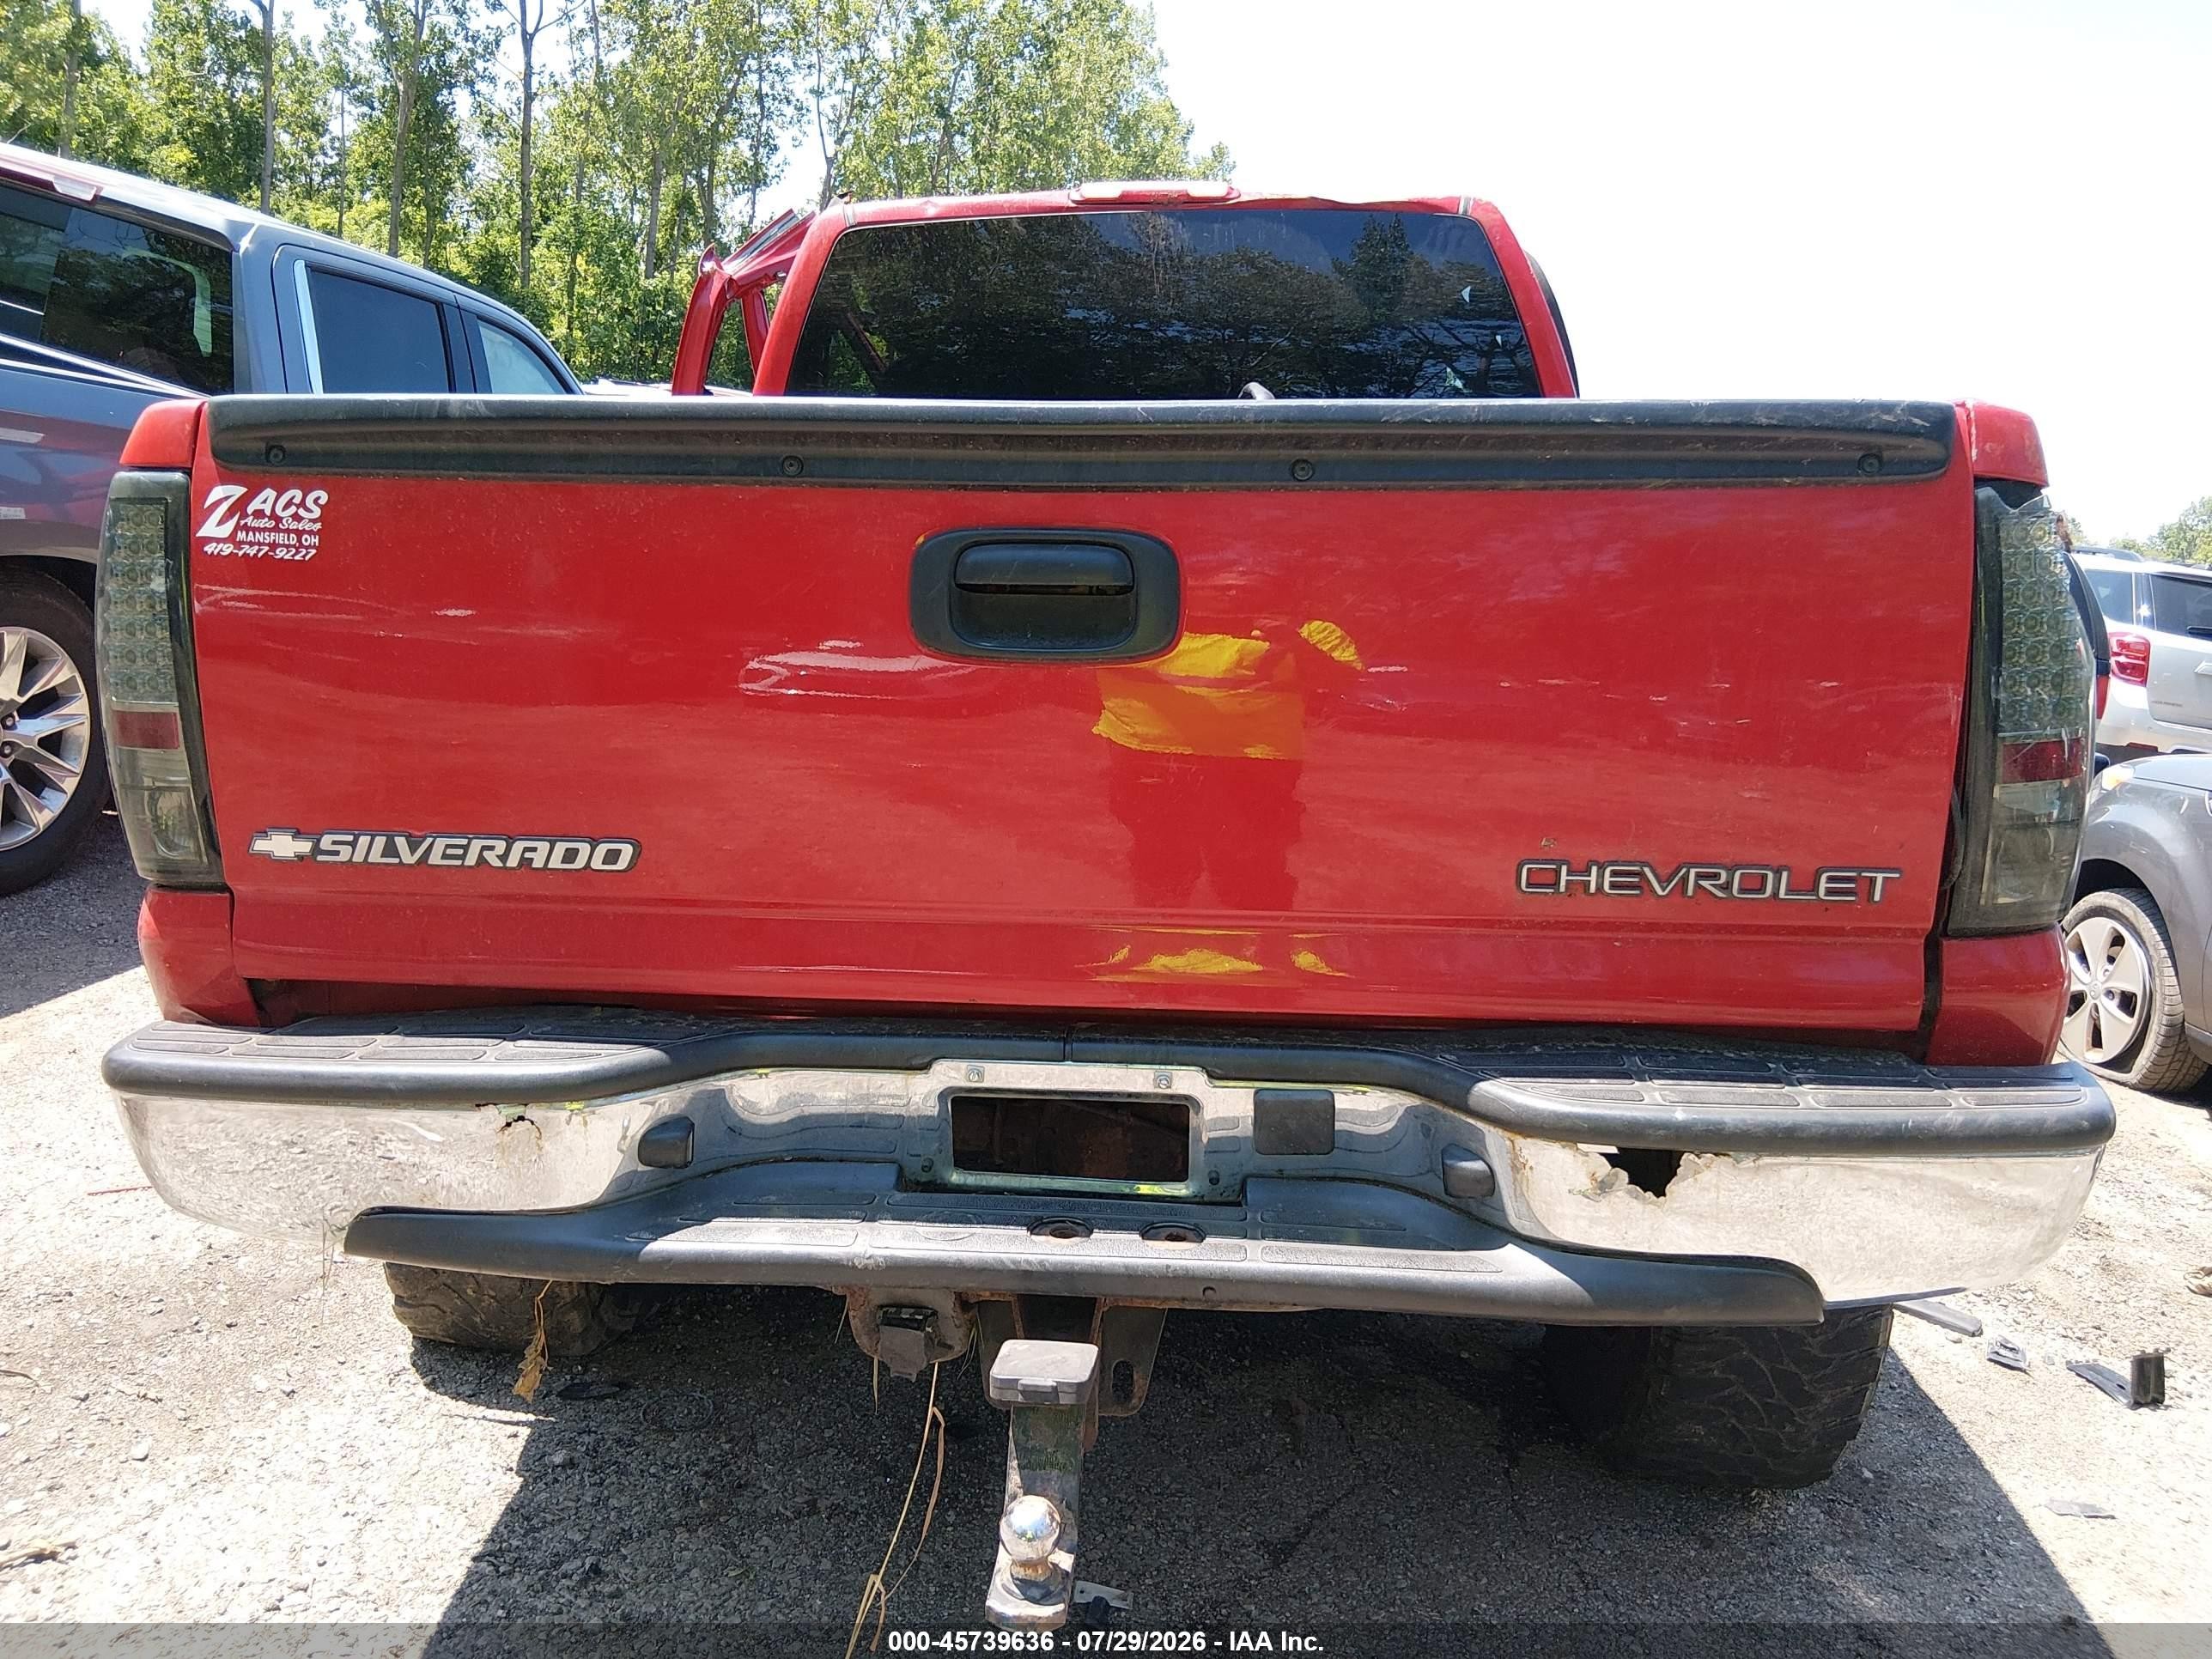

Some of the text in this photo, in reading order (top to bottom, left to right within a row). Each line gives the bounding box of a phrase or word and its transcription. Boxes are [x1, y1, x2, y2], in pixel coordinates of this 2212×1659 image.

[240, 515, 322, 532] Auto Sales
[237, 531, 319, 547] MANSFIELD, OH
[204, 542, 317, 561] 419-747-9227
[314, 832, 639, 872] SILVERADO
[1518, 860, 1901, 902] CHEVROLET
